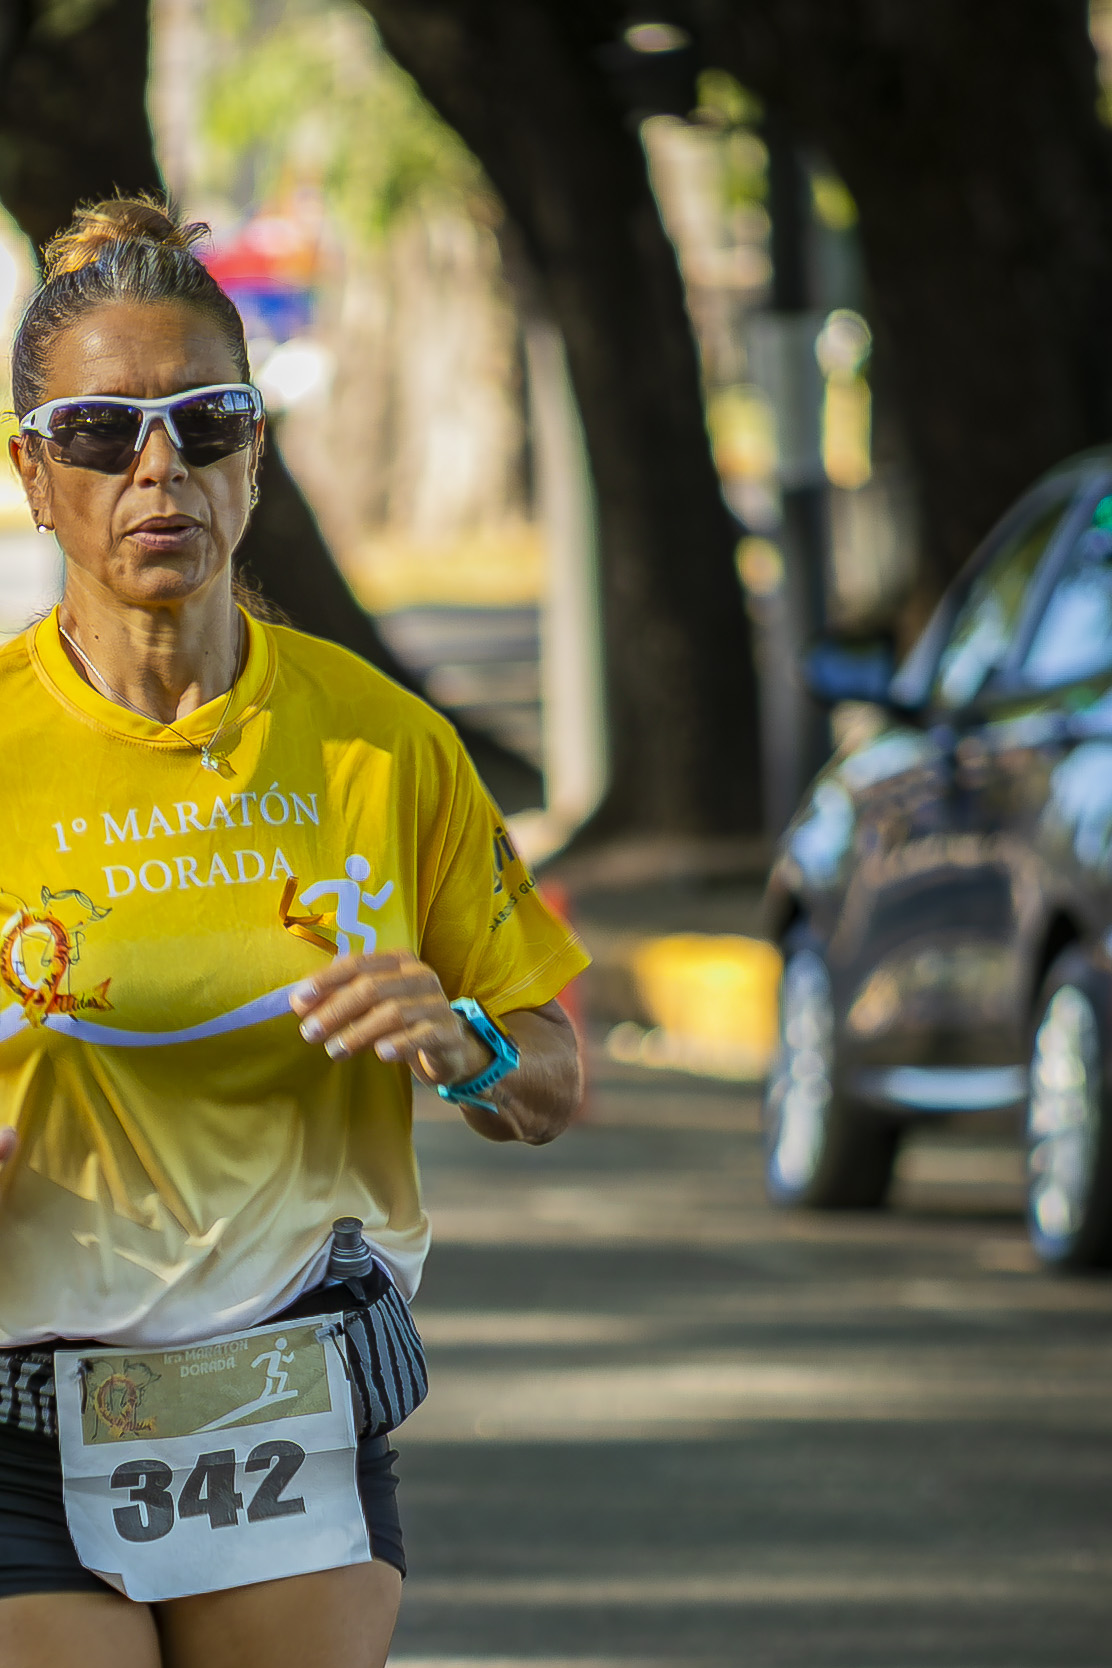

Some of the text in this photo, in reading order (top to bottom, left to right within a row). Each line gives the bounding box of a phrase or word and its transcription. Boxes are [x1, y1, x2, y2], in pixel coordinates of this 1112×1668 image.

[101, 781, 319, 845] MARATÓN
[102, 847, 295, 898] DORADA
[180, 1356, 237, 1377] DORADA
[110, 1439, 307, 1543] 342
